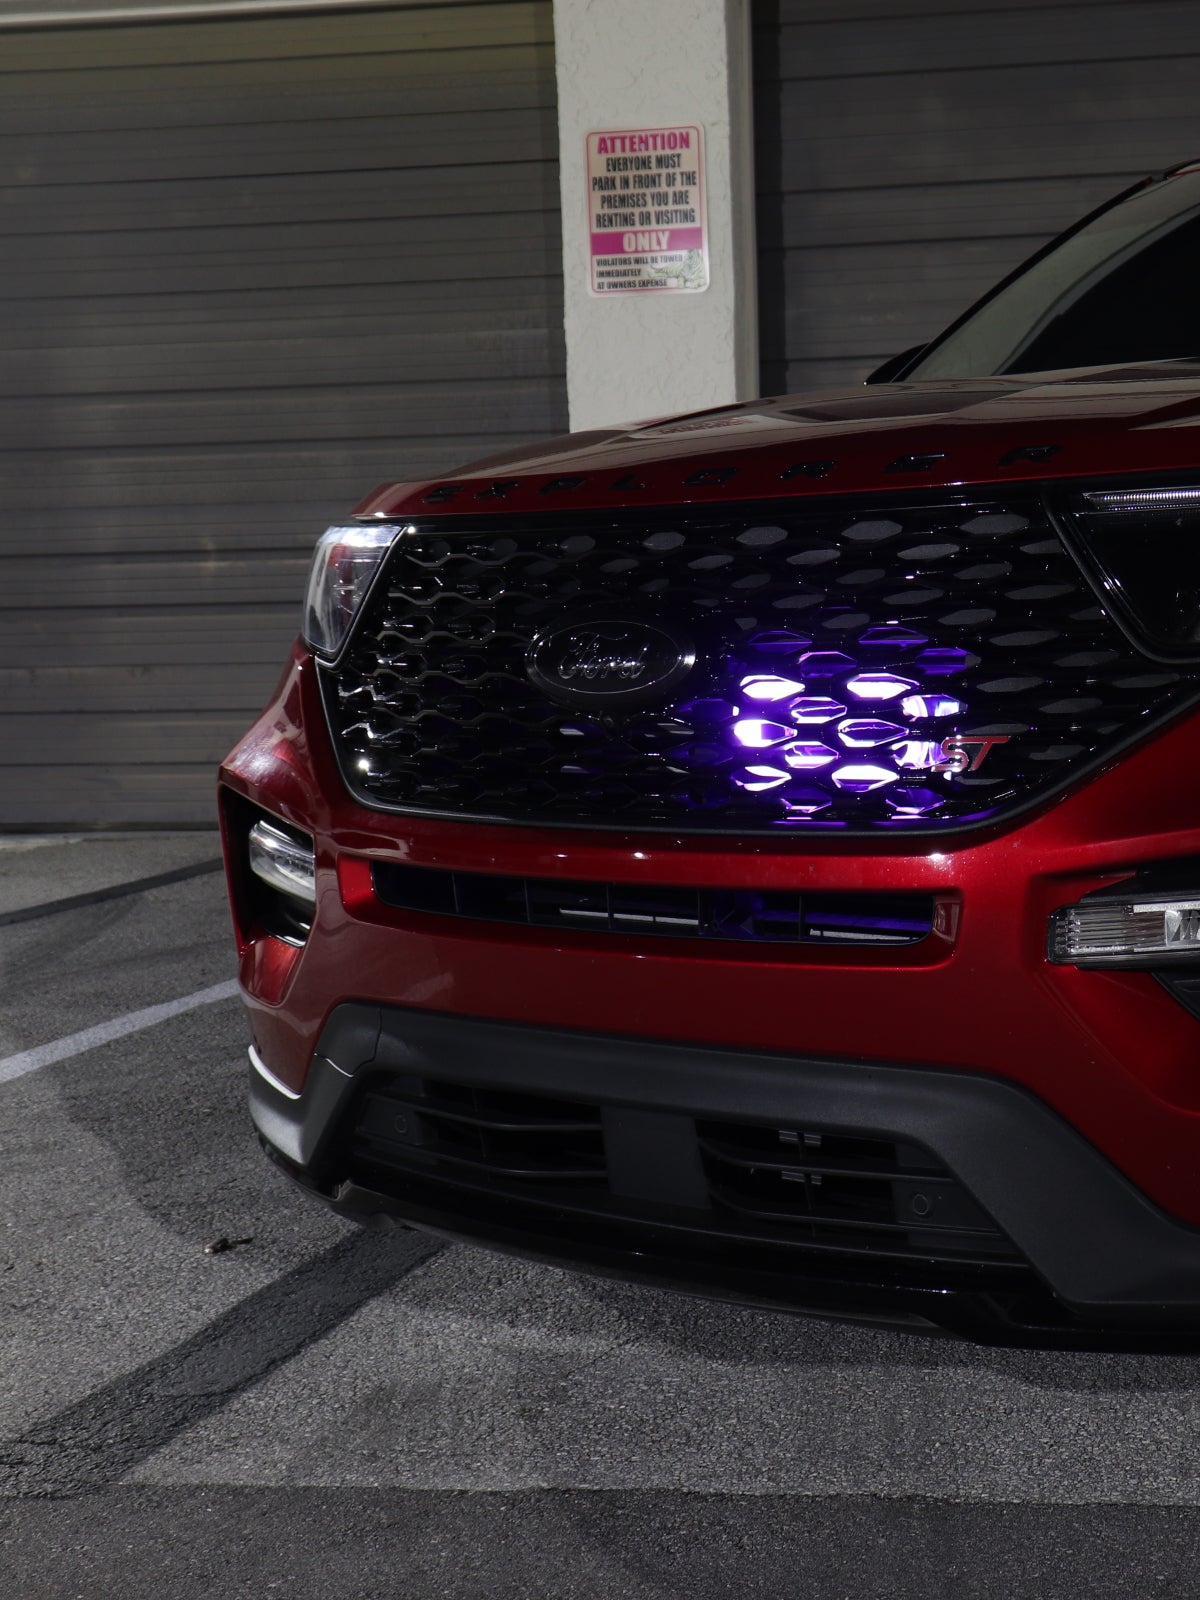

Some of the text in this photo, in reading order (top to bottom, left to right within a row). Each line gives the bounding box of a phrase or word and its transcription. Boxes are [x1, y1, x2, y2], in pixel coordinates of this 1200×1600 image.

[597, 131, 690, 154] ATTENTION
[606, 153, 682, 172] EVERYONE MUST
[592, 171, 697, 191] PARK IN FRONT OF THE
[600, 190, 690, 209] PREMISES YOU ARE
[596, 209, 696, 228] RENTING OR VISITING
[622, 230, 670, 252] ONLY
[596, 254, 683, 266] VIOLATORS WILL BE TOWED
[596, 268, 641, 278] IMMEDIATELY
[606, 280, 636, 289] OWNERS
[638, 278, 667, 288] EXPENSE
[420, 444, 1061, 503] EXPLORER
[558, 631, 649, 679] Ford
[931, 735, 1011, 772] ST
